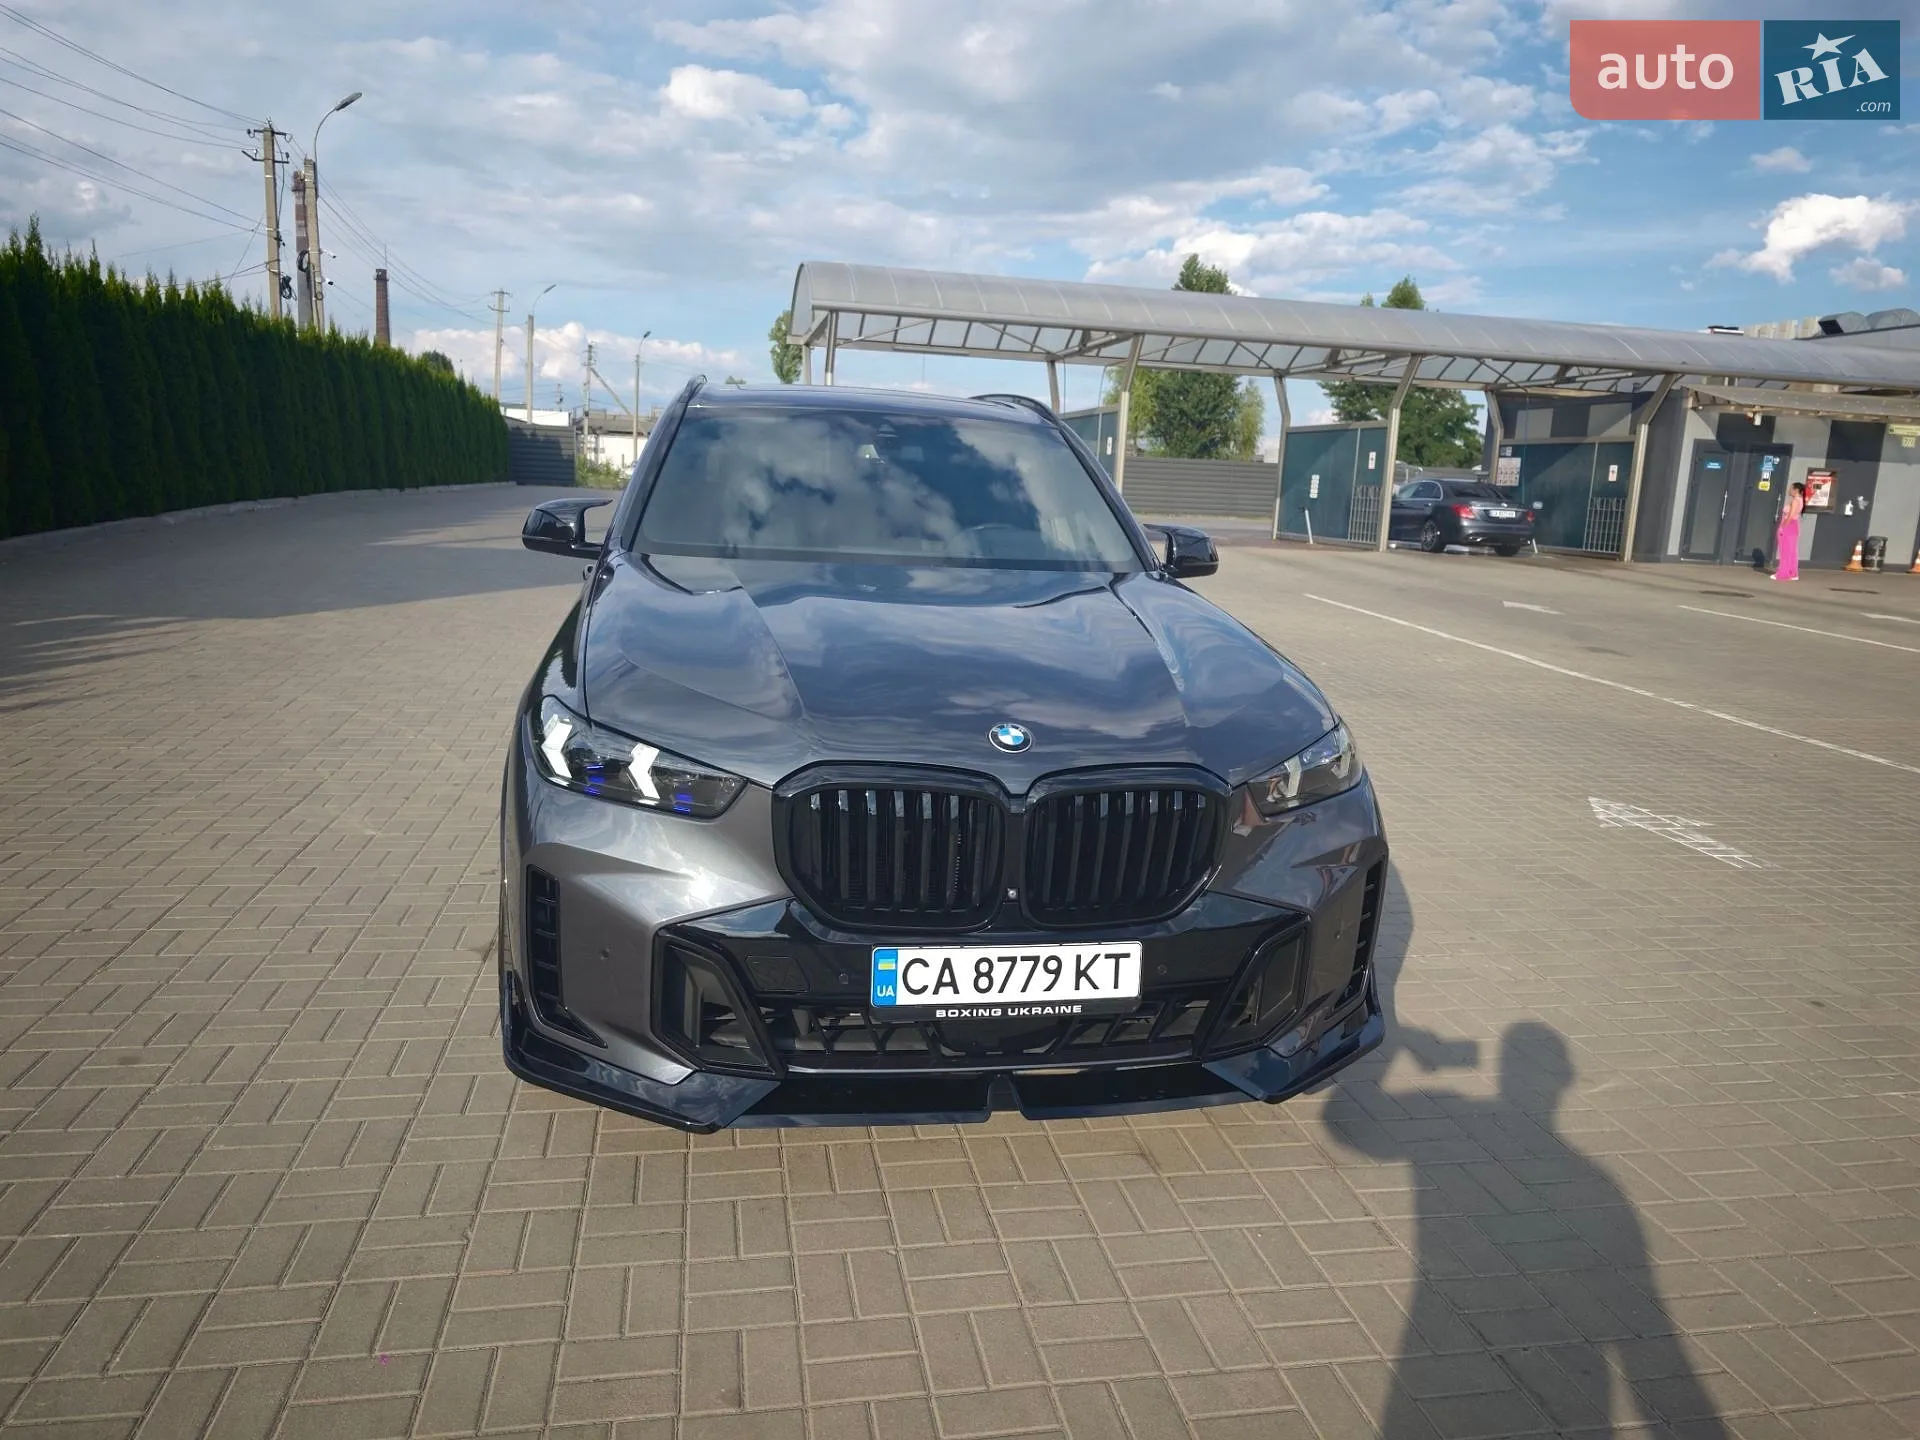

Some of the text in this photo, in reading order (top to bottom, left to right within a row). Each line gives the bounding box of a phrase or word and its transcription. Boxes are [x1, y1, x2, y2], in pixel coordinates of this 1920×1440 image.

[902, 952, 1131, 995] CA 8779 KT
[877, 985, 895, 997] UA
[935, 1005, 1082, 1018] BOXING UKRAINE
